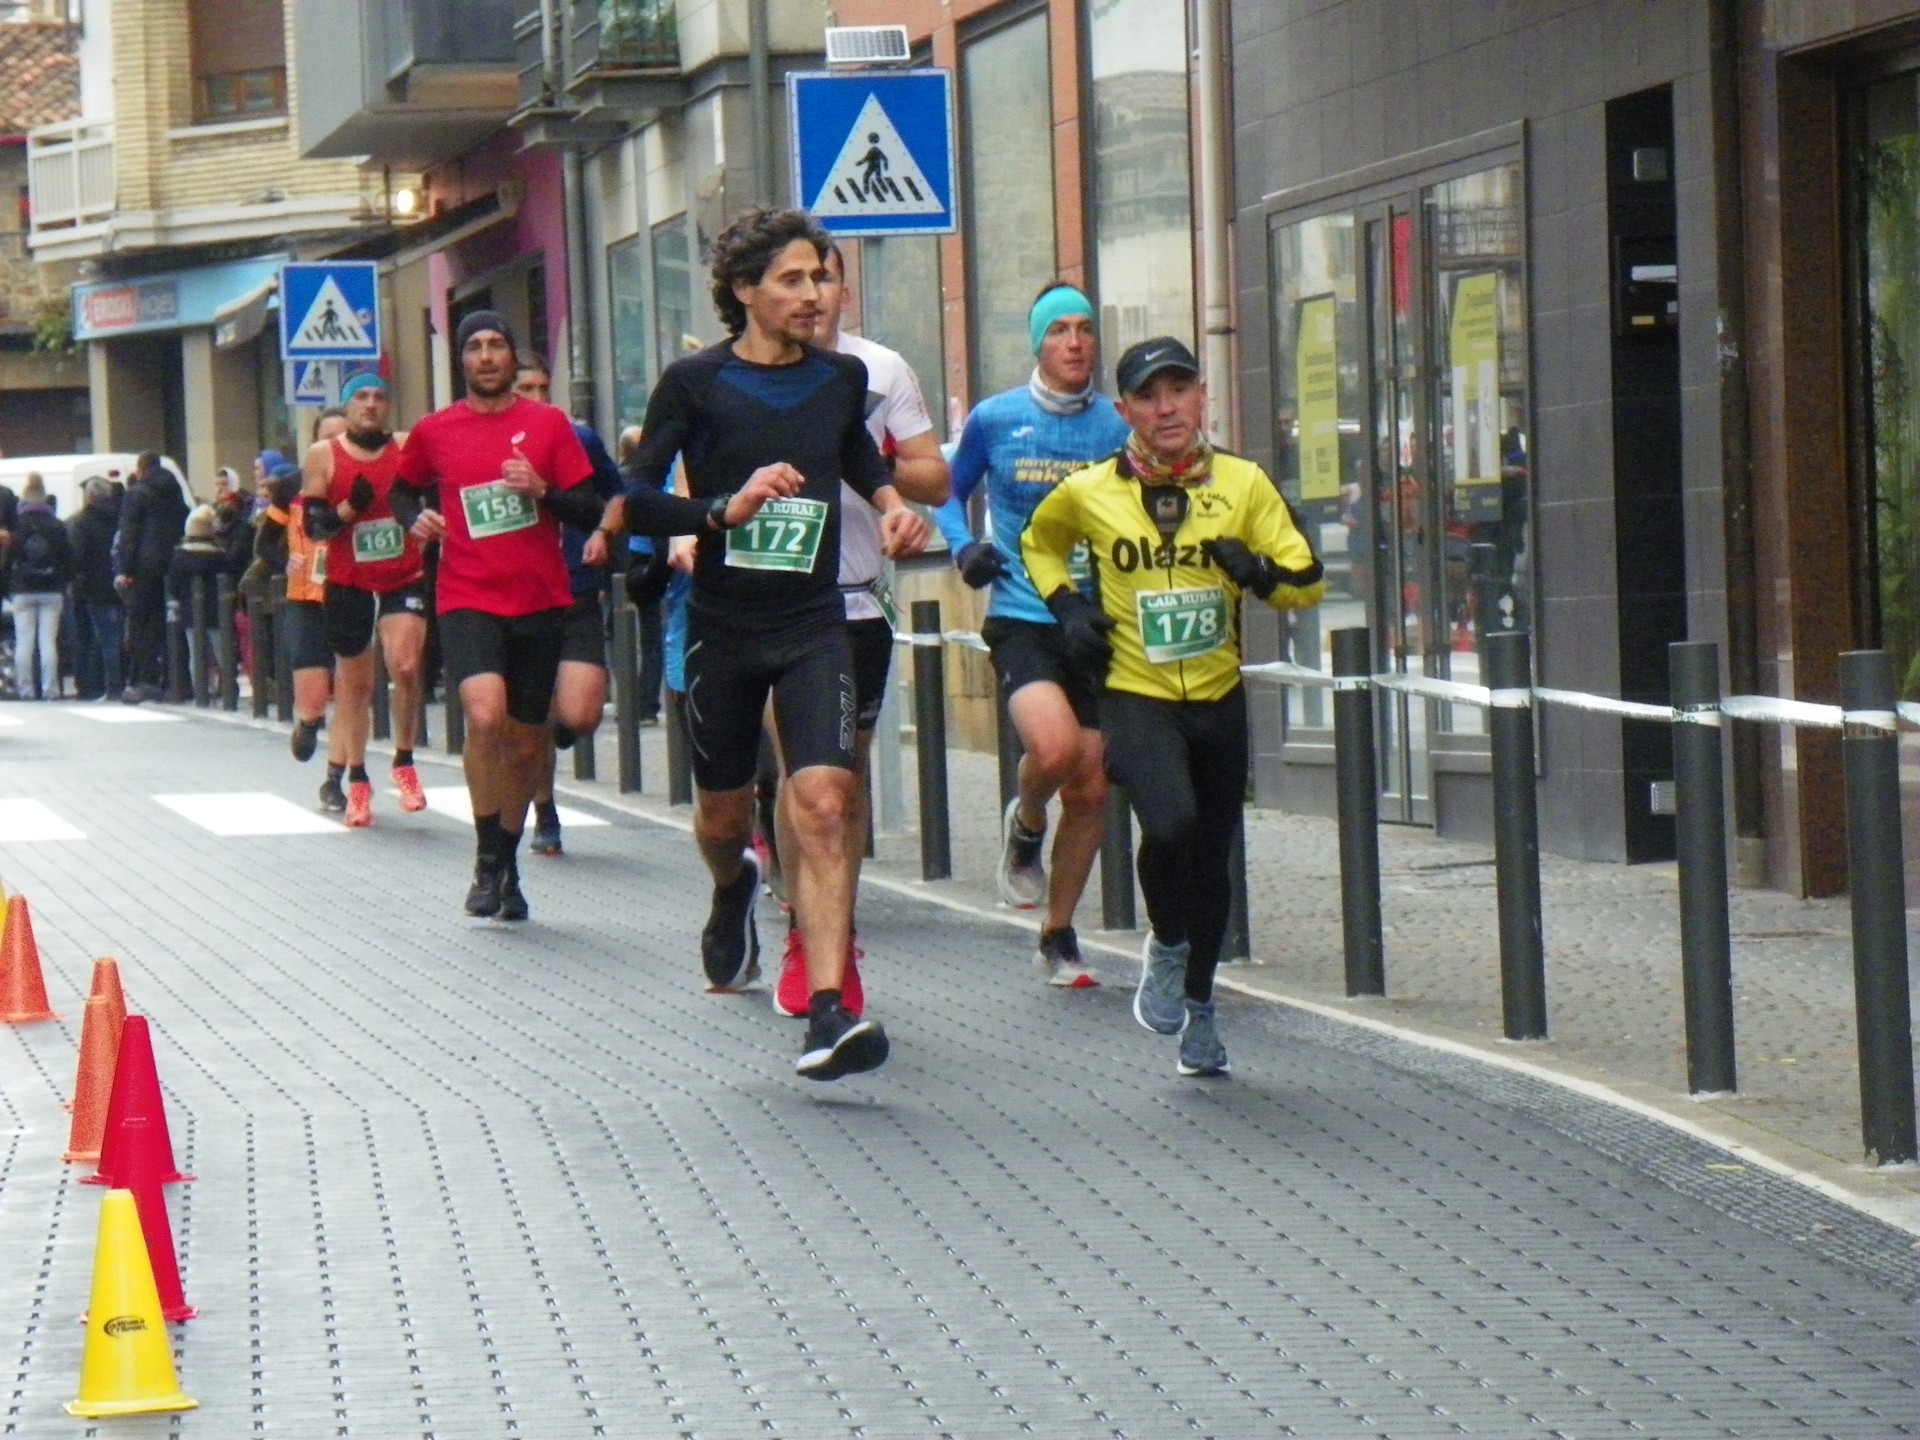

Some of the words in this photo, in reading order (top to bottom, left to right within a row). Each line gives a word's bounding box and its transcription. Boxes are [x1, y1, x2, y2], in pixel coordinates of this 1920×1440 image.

[477, 494, 522, 522] 158
[773, 502, 818, 517] RURAL
[363, 530, 396, 550] 161
[744, 519, 807, 552] 172
[1156, 607, 1217, 643] 178
